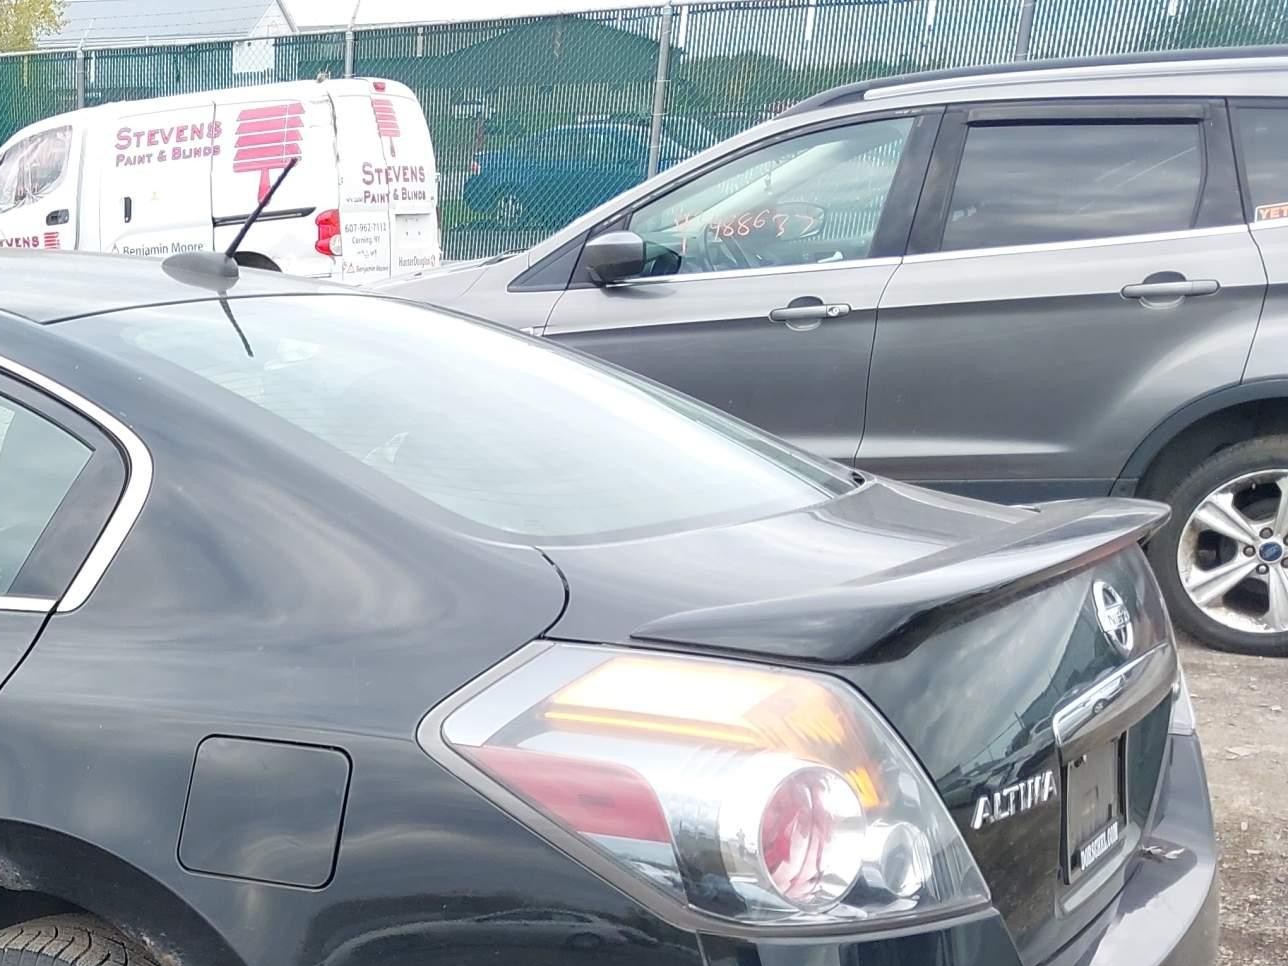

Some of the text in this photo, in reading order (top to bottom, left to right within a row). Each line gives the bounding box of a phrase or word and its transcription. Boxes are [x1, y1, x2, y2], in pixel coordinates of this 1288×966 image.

[115, 121, 222, 151] STEVENS
[116, 145, 221, 168] PAINT & BLINDS
[362, 161, 426, 185] STEVENS
[363, 190, 390, 204] PAINT
[393, 188, 399, 200] &
[401, 187, 426, 201] BLINDS
[123, 242, 204, 256] Benjamin Moore
[970, 769, 1058, 830] ALTIMA
